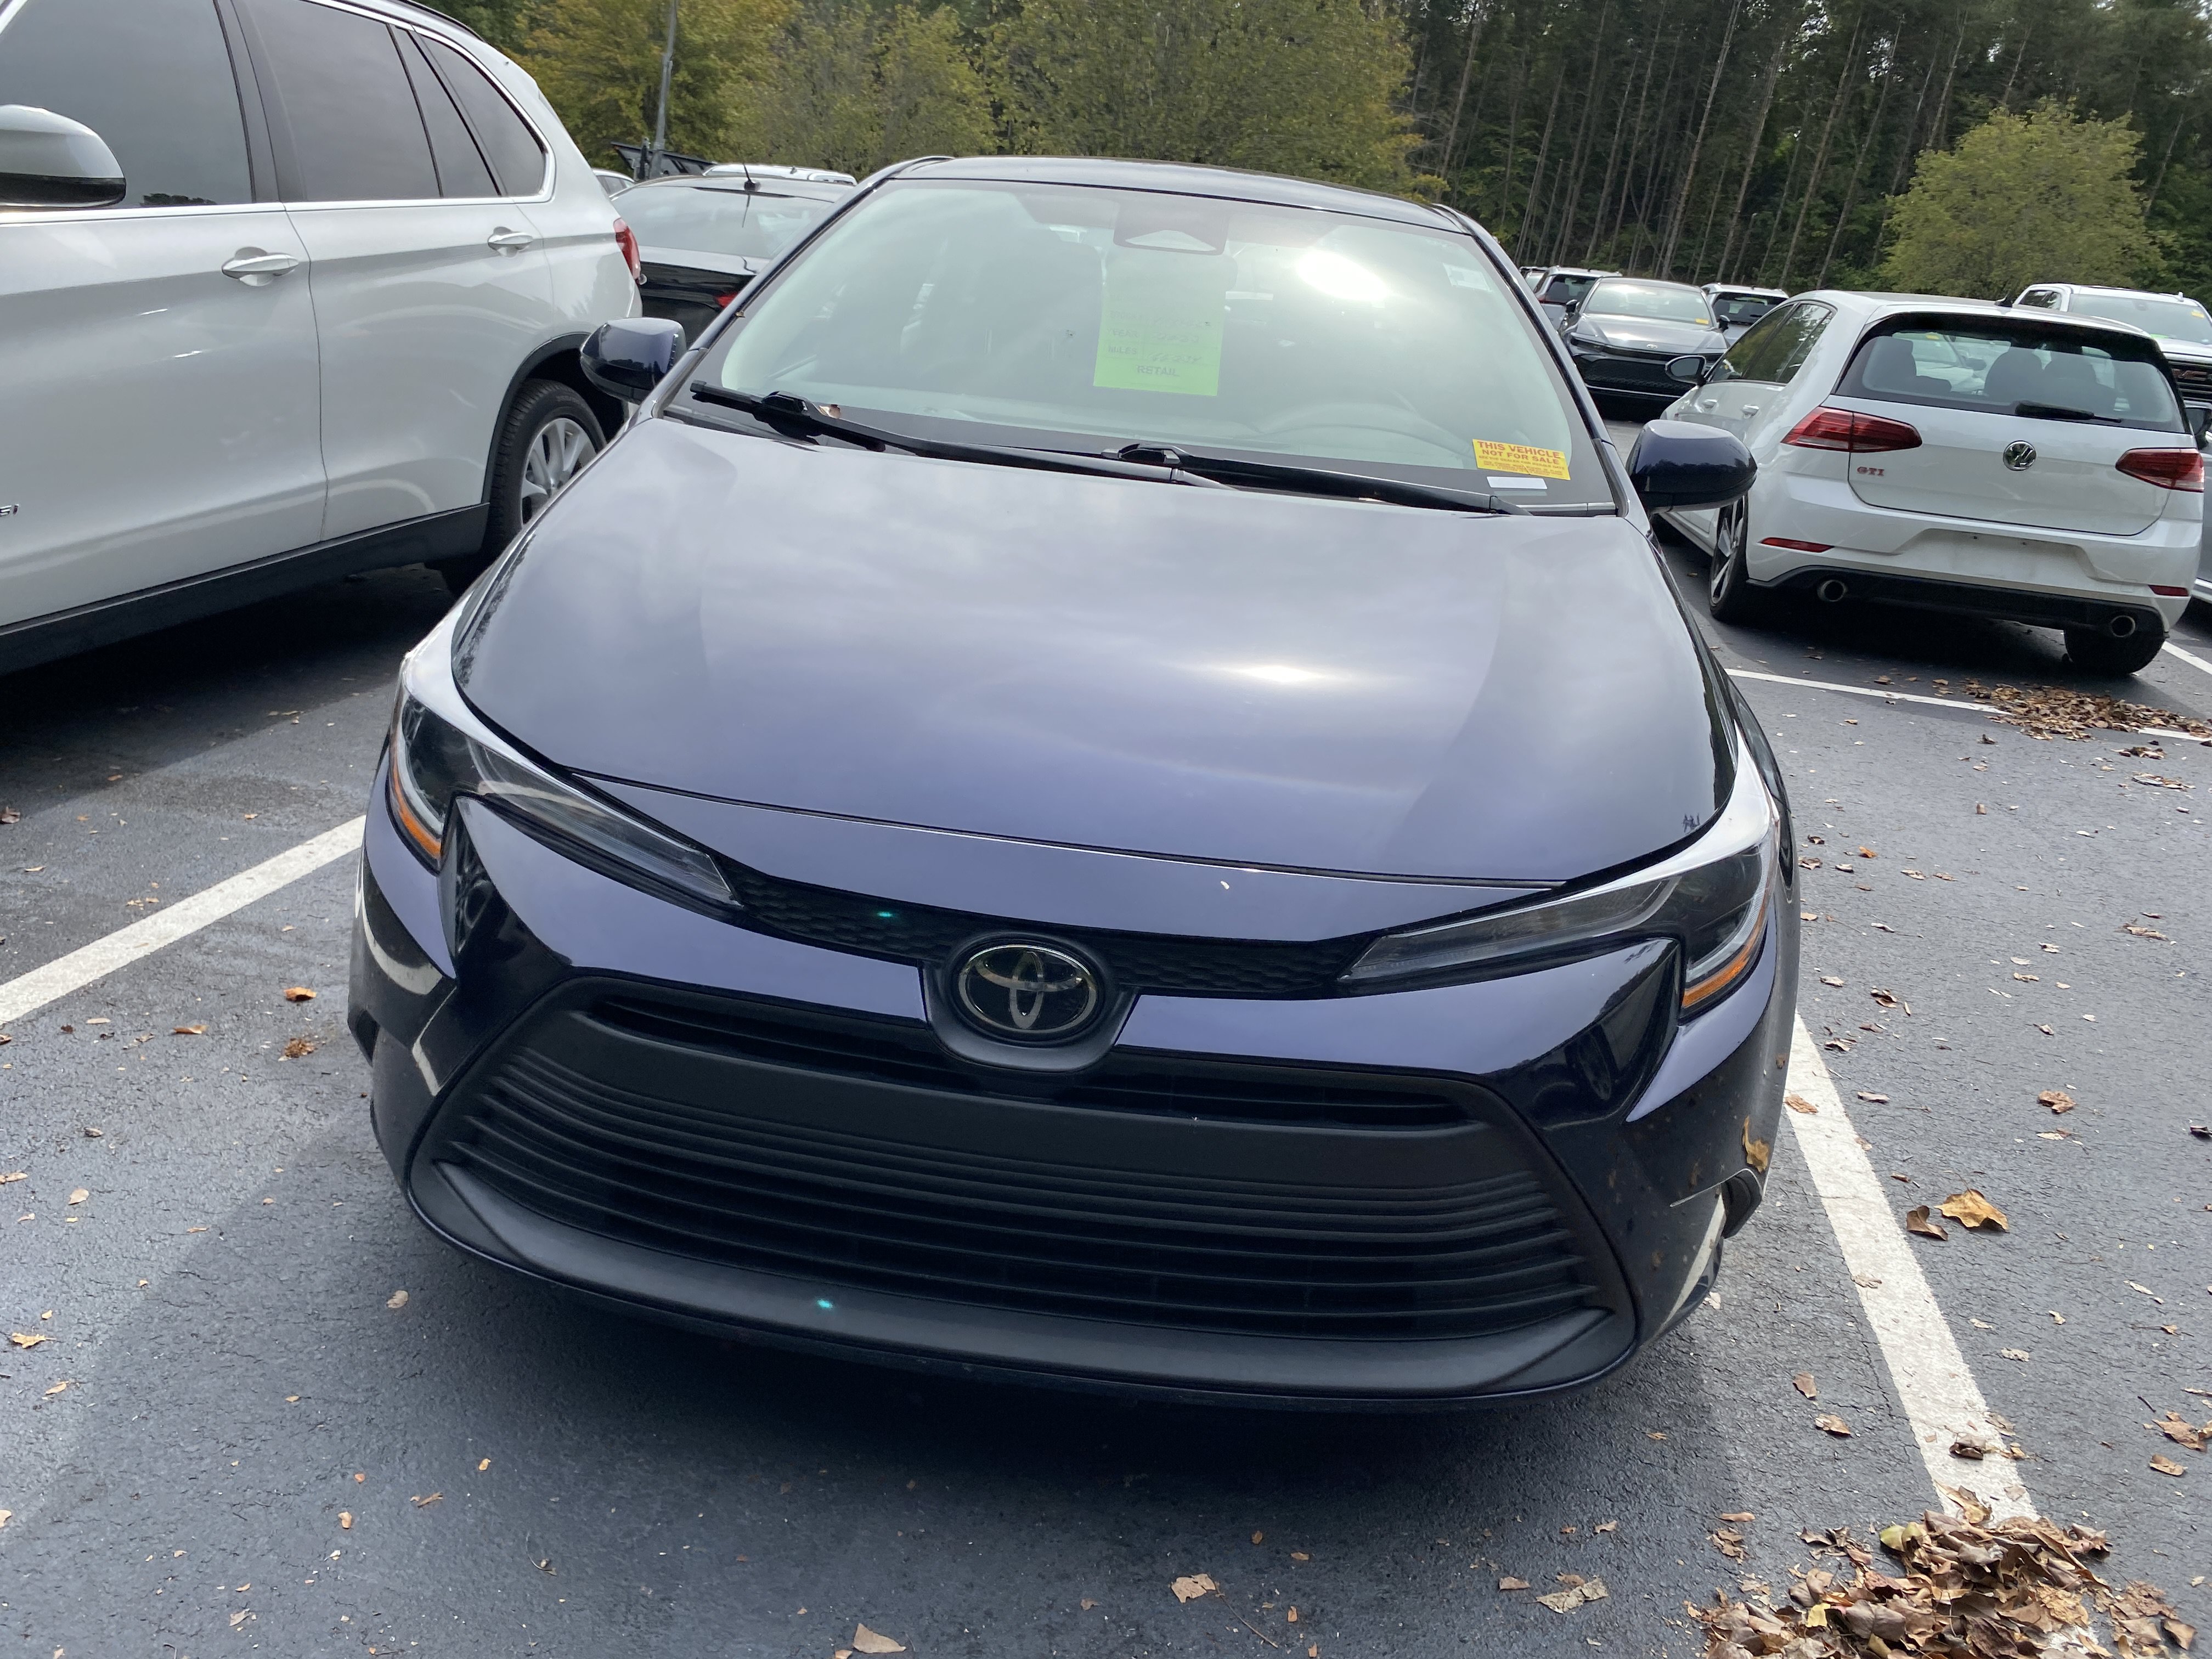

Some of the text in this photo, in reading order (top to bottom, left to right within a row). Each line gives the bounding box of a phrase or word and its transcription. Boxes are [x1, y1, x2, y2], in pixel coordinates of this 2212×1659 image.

[1107, 328, 1138, 338] YEAR
[1108, 346, 1137, 355] MILES
[1136, 365, 1180, 377] RETAIL
[1477, 441, 1561, 459] THIS VEHICLE
[1532, 456, 1560, 465] SALE
[1857, 466, 1884, 477] GTI
